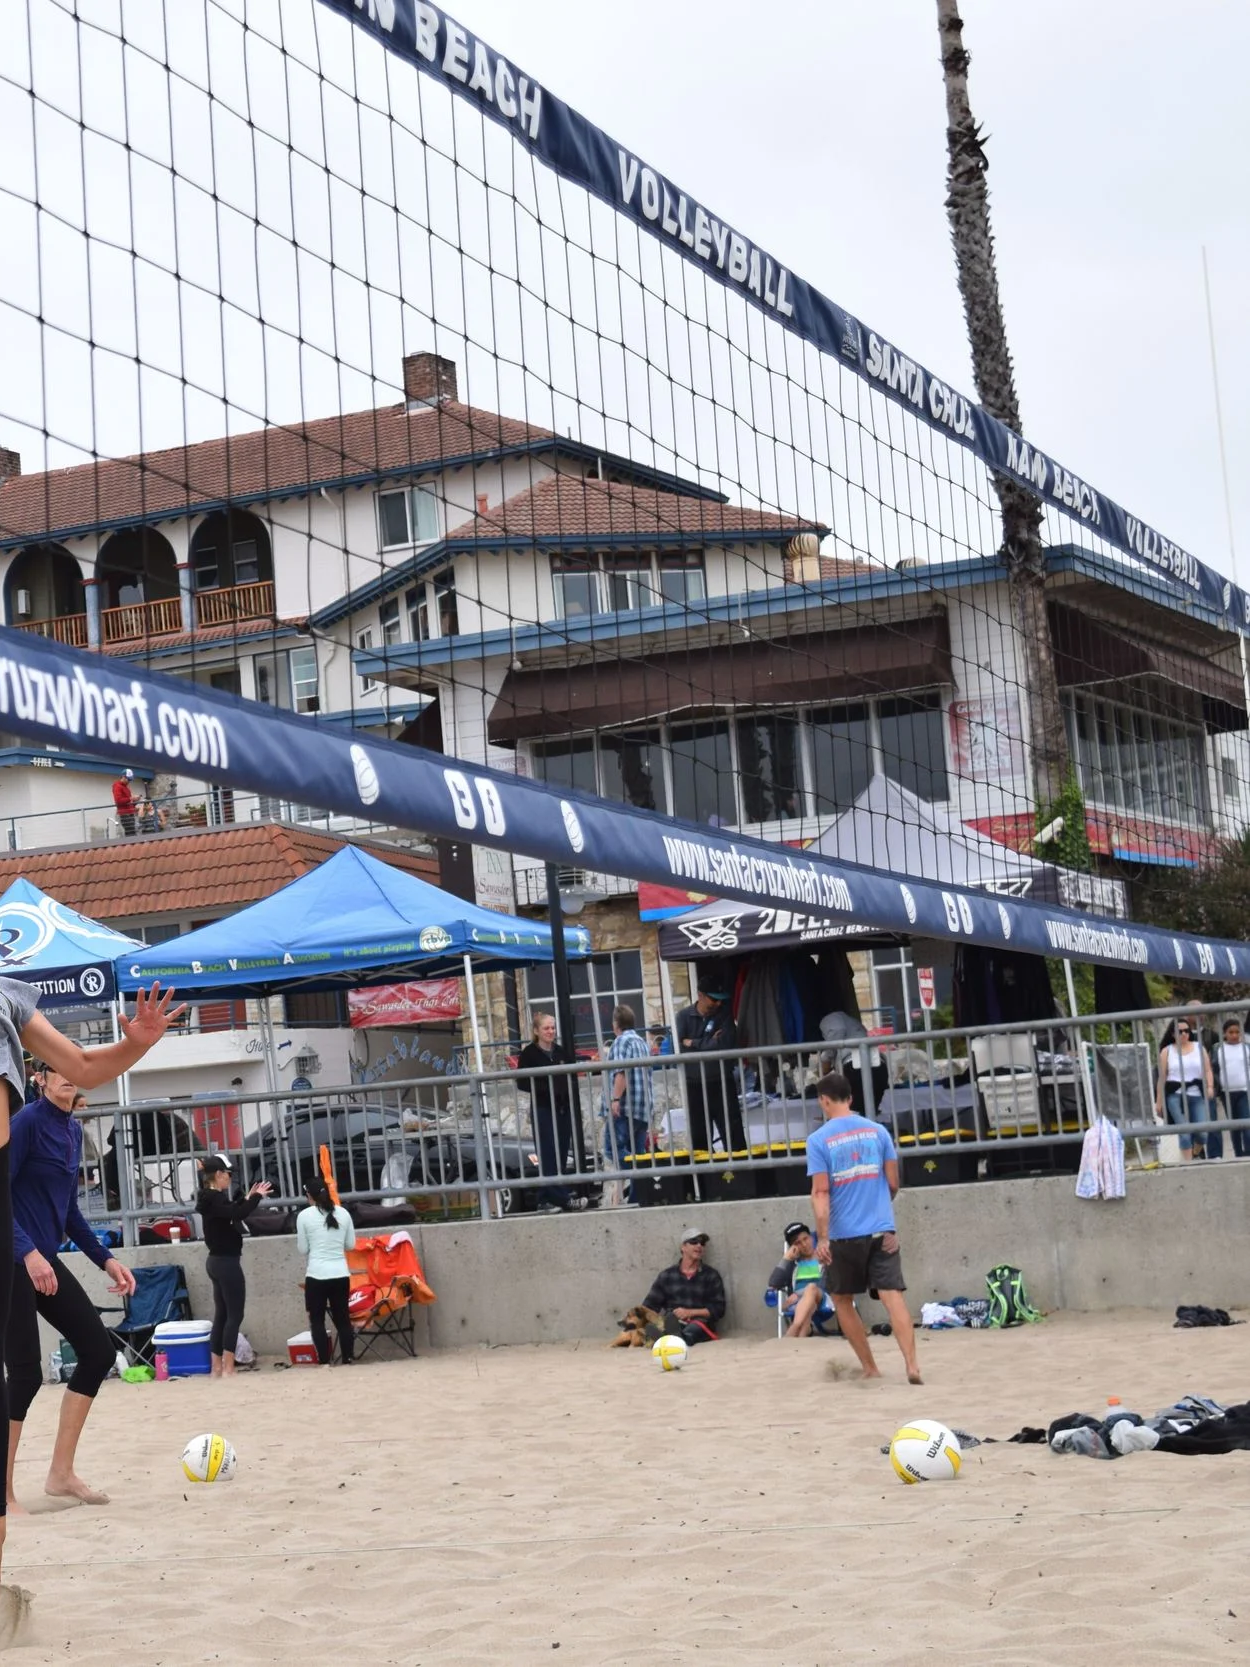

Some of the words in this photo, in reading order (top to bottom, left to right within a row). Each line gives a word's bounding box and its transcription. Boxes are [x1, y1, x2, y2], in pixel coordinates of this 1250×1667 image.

[414, 0, 543, 139] BEACH
[618, 149, 794, 318] VOLLEYBALL
[865, 333, 924, 410] SANTA
[928, 378, 976, 442] CRUZ
[1006, 432, 1047, 490] MAIN
[1052, 463, 1100, 545] BEACH
[1126, 515, 1200, 591] VOLLEYBALL
[661, 835, 854, 912] www.santacruzwharf.com
[800, 929, 824, 941] SANTA
[823, 926, 845, 938] CRUZ
[191, 960, 227, 975] BEACH
[926, 1431, 946, 1459] Wilson
